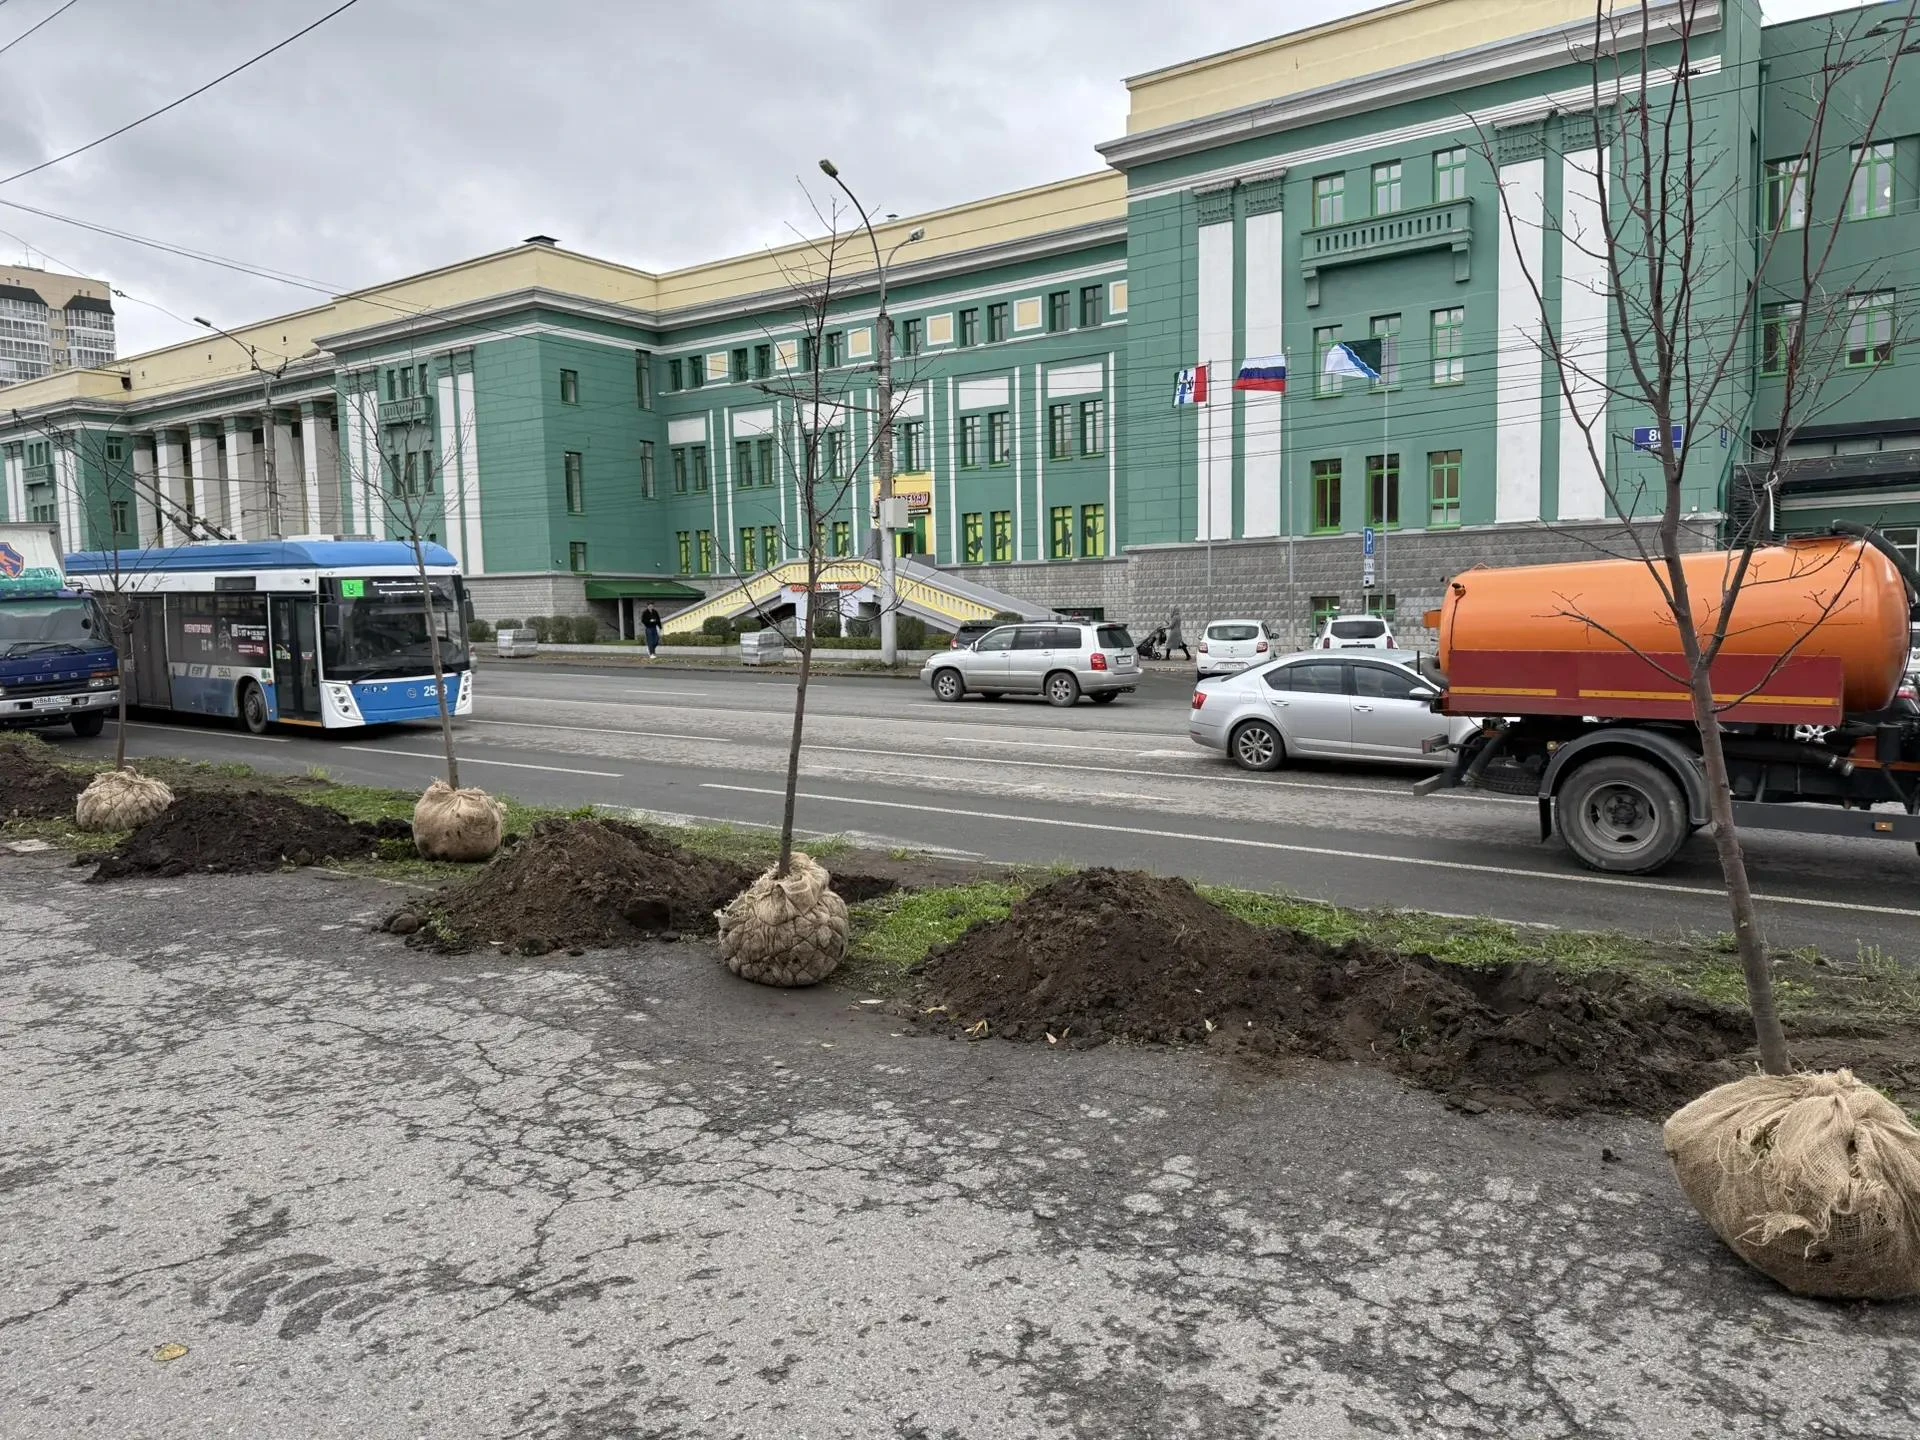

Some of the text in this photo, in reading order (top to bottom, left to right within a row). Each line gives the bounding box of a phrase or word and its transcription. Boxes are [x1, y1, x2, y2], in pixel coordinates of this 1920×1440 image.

[1366, 530, 1372, 552] P
[17, 672, 78, 682] FUSO
[423, 684, 448, 697] 253
